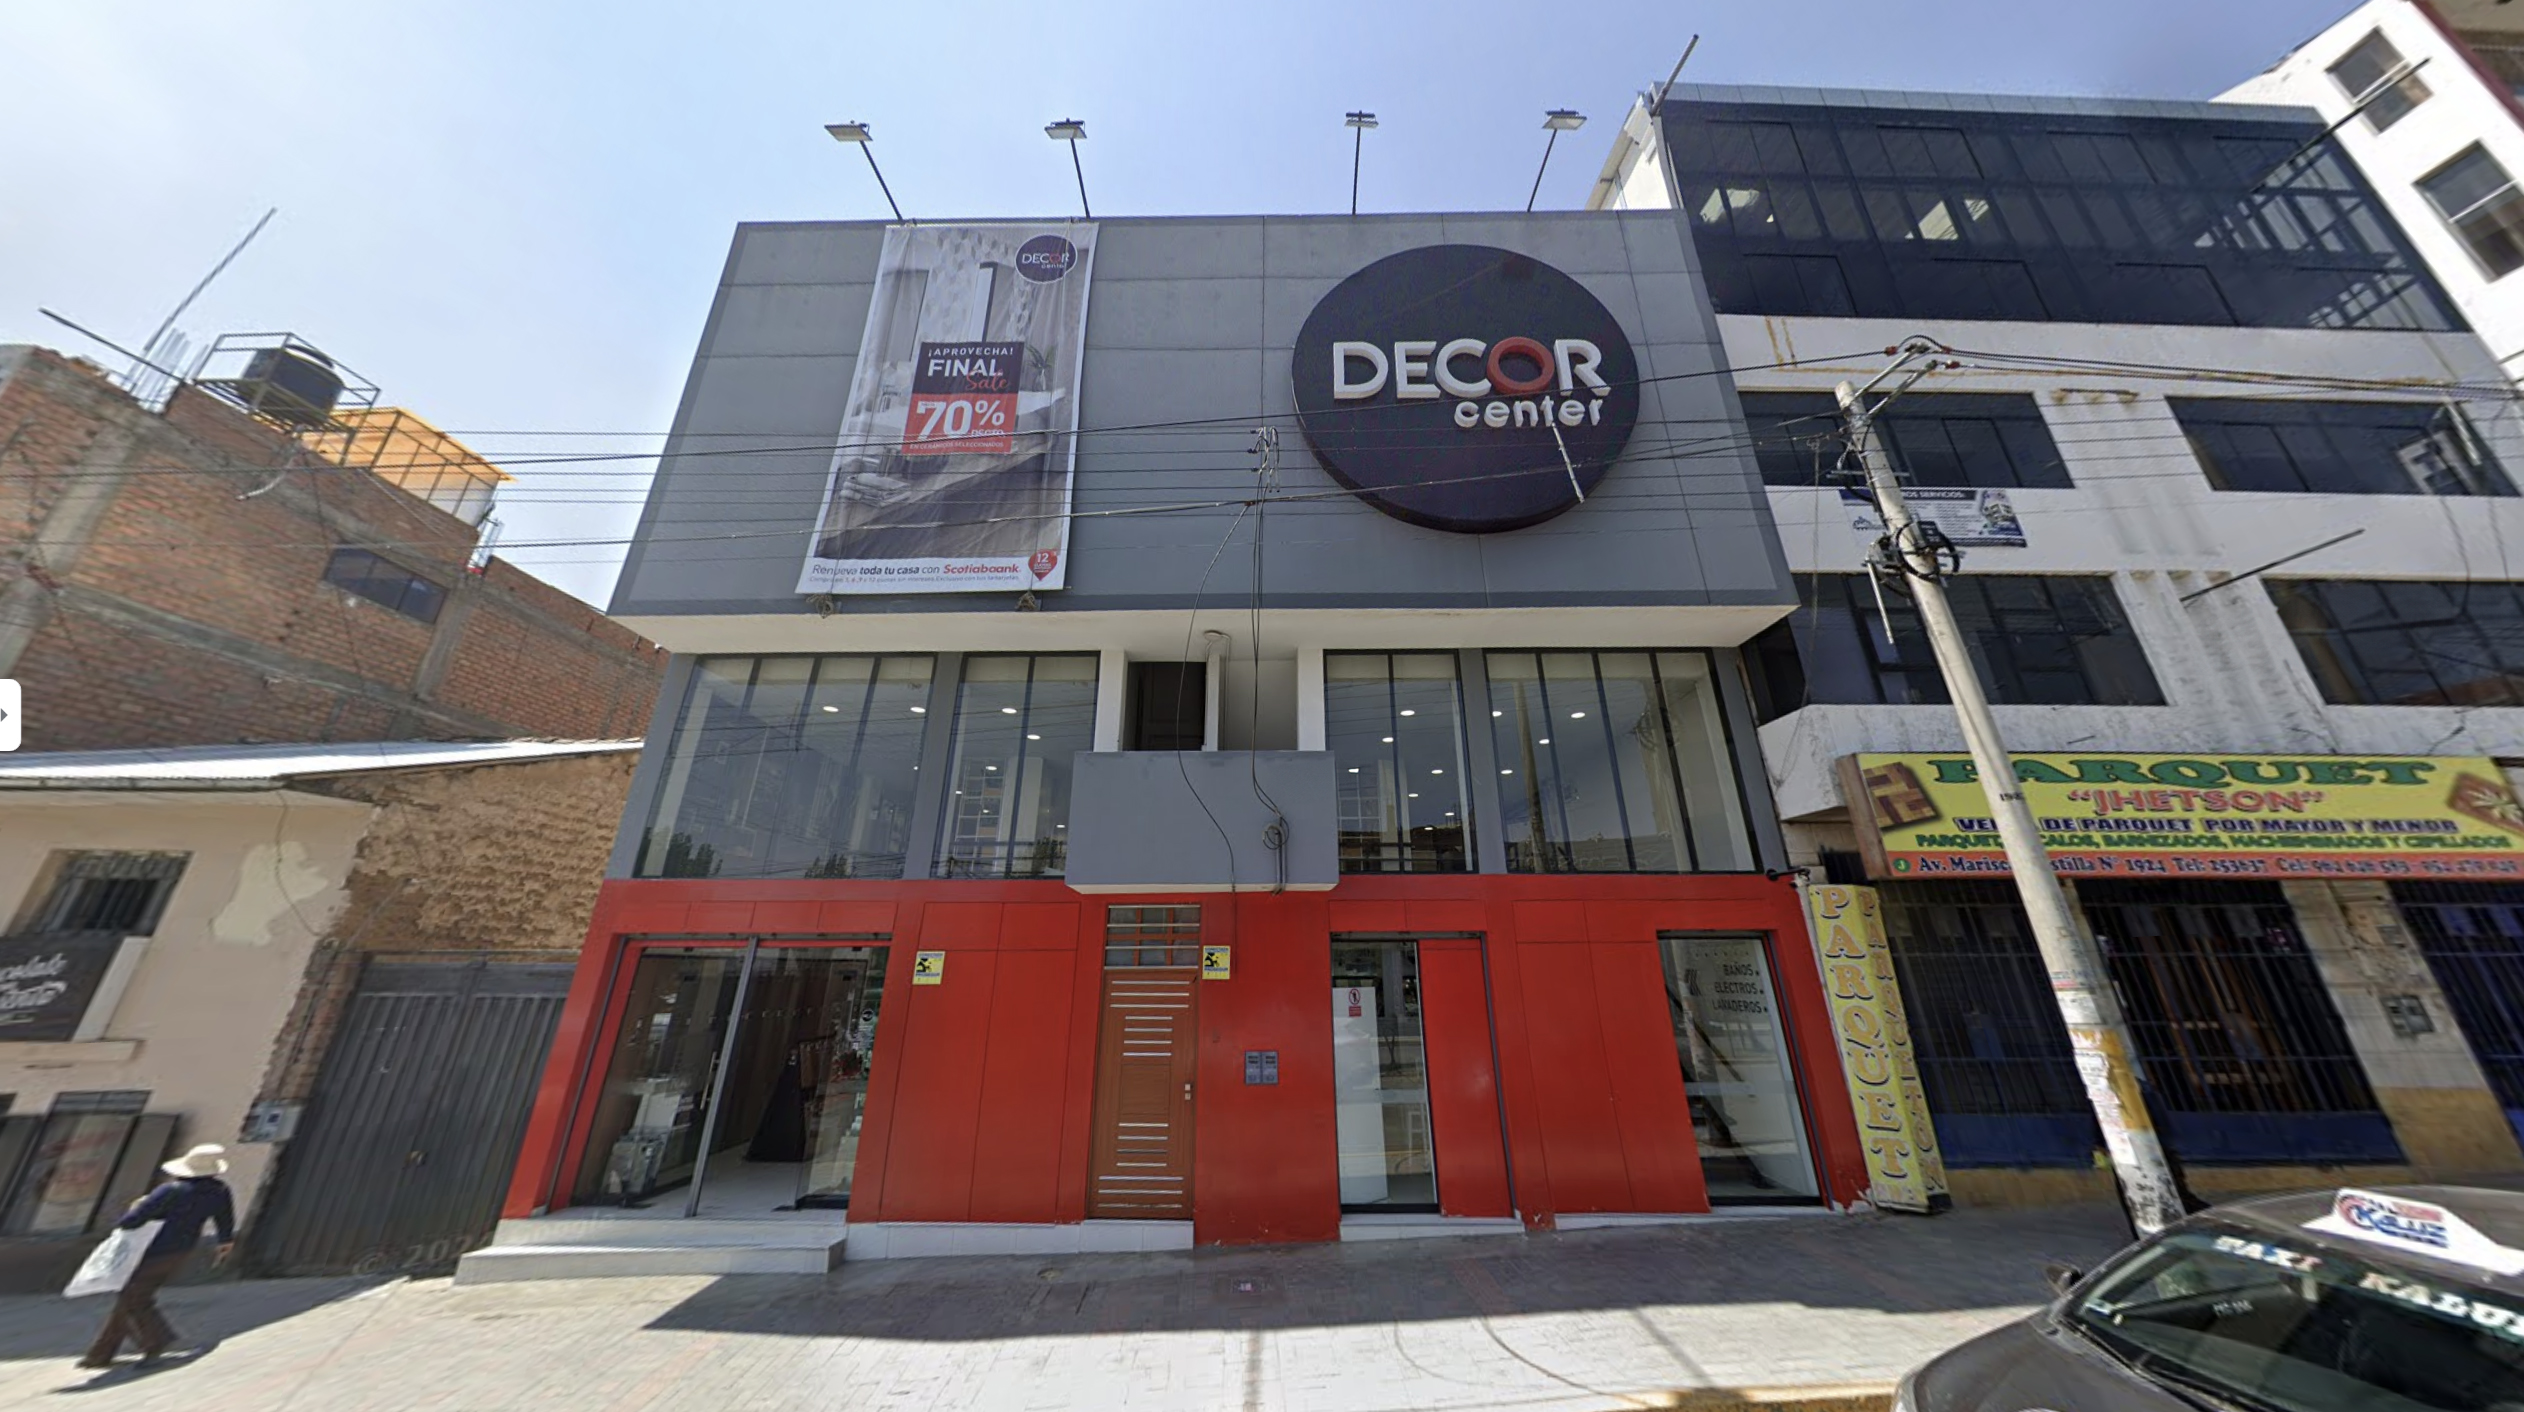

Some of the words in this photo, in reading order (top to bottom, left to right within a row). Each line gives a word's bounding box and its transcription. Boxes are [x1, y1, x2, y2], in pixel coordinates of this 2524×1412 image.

[928, 347, 1014, 357] ¡APROVECHA!
[928, 358, 1004, 377] FINAL
[1333, 336, 1611, 399] DECOR
[965, 368, 1009, 391] Sale
[916, 399, 1005, 441] 70%
[1454, 395, 1603, 428] center
[1037, 552, 1049, 562] 12
[859, 565, 882, 576] toda
[884, 566, 895, 575] tu
[897, 566, 919, 575] casa
[921, 565, 940, 575] con
[1927, 760, 2436, 788] PARQUET
[2040, 818, 2078, 832] DE
[2078, 818, 2194, 832] PARQUET
[2201, 819, 2256, 832] POR
[2259, 819, 2347, 833] MAYOR
[2370, 819, 2459, 834] MENOR
[1919, 857, 1946, 871] Av.
[1950, 857, 2012, 872] Marisc
[2050, 856, 2096, 872] stilla
[1714, 981, 1759, 995] ELECTROS
[1711, 1000, 1763, 1014] LAVADEROS
[1812, 886, 1910, 1179] PARQUET
